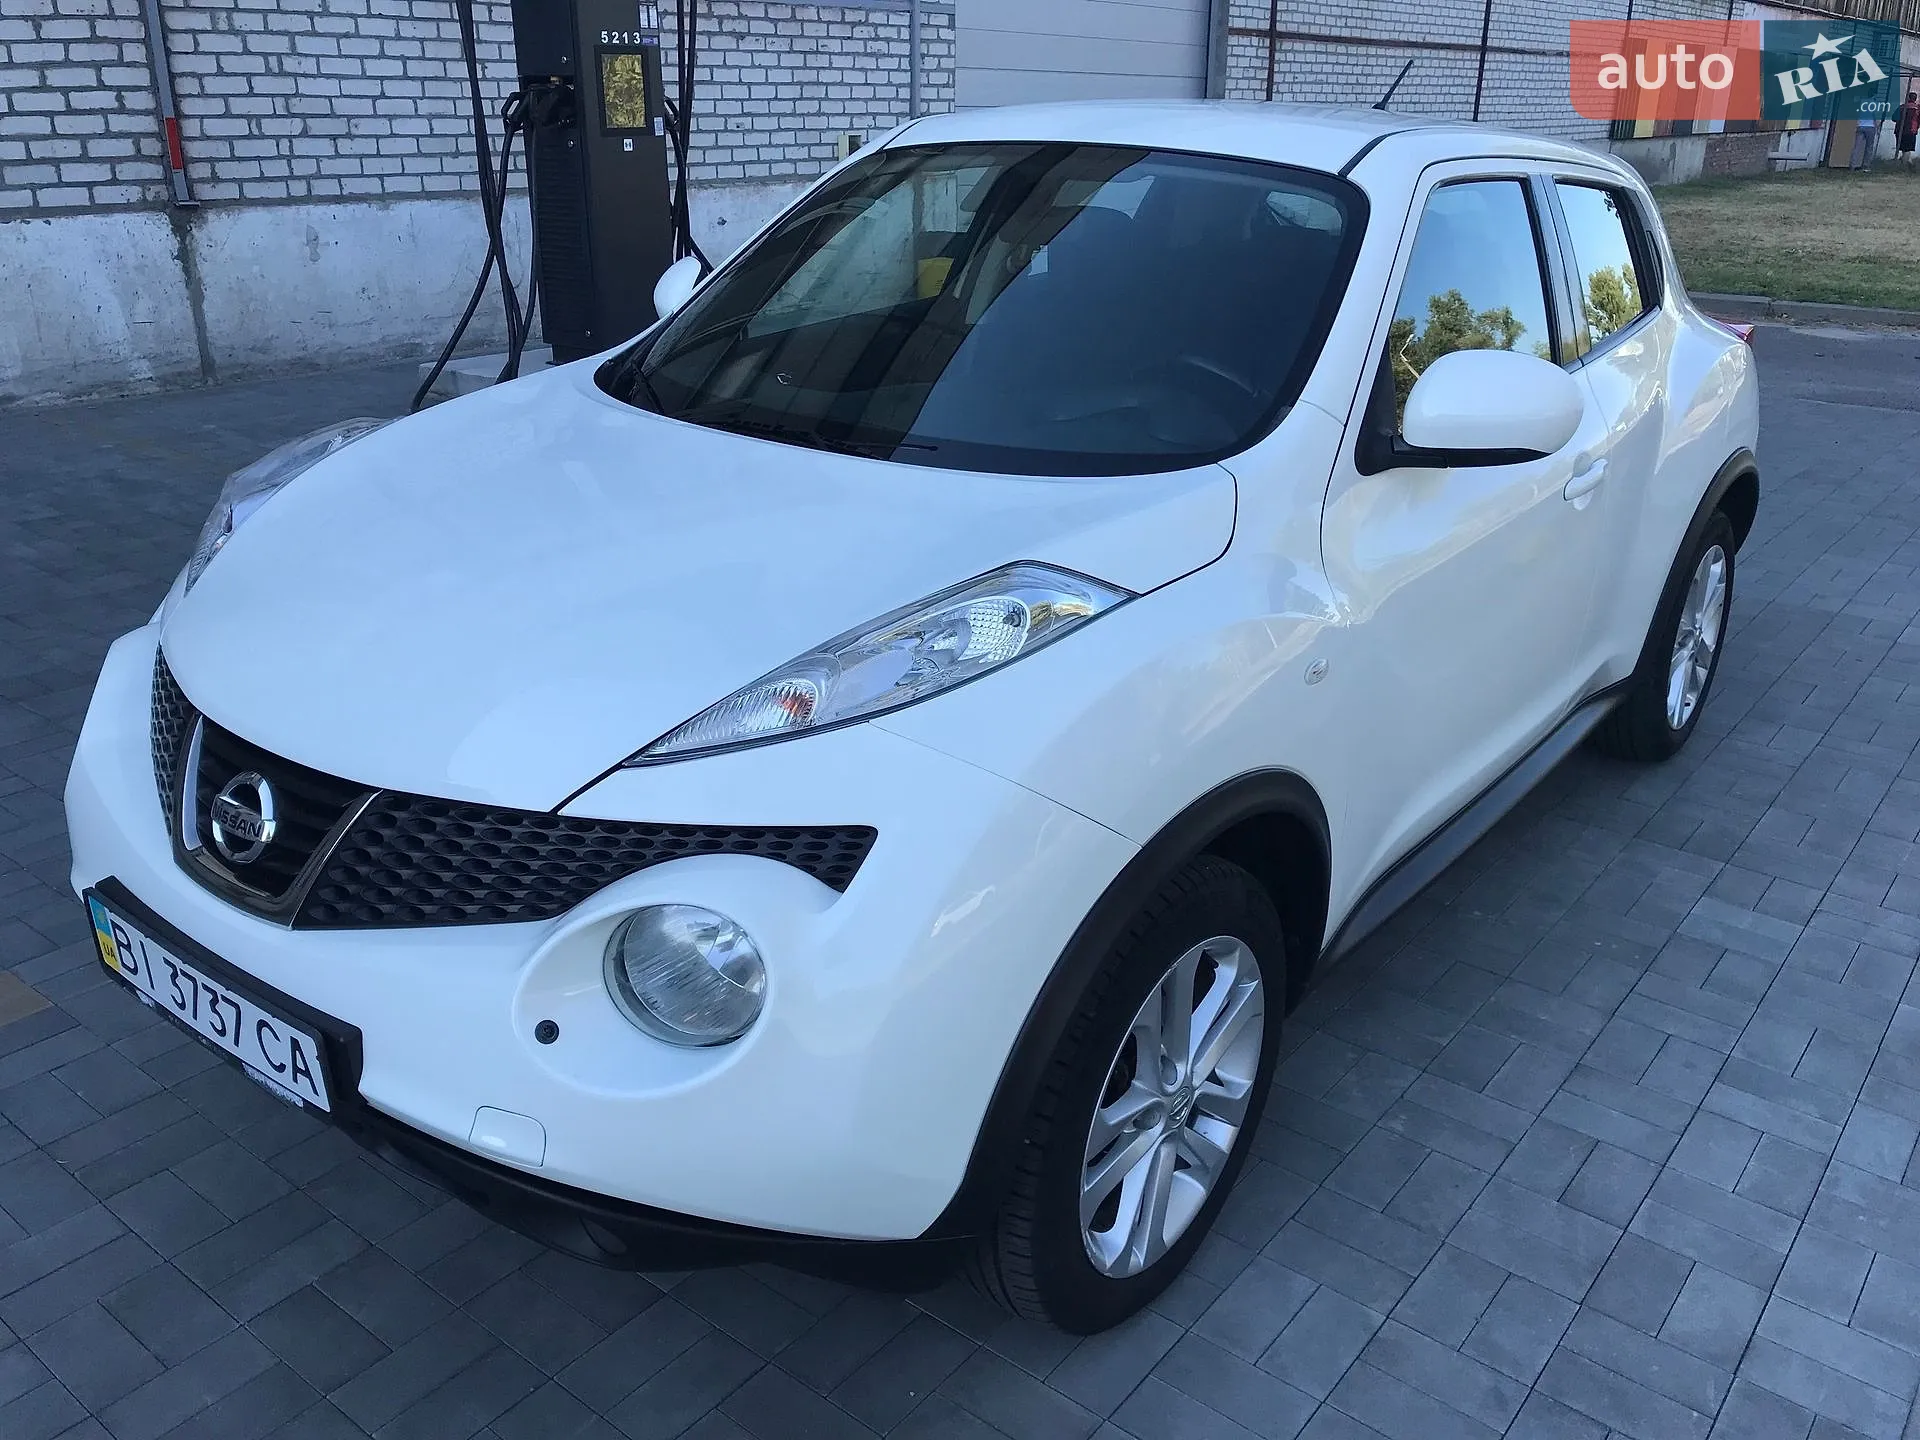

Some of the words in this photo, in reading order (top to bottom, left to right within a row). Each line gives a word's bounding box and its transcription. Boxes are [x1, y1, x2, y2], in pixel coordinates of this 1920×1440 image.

[601, 30, 641, 44] 5213
[213, 801, 262, 838] NISSAN
[102, 942, 118, 962] UA
[162, 956, 242, 1048] 3737
[256, 1018, 319, 1097] CA
